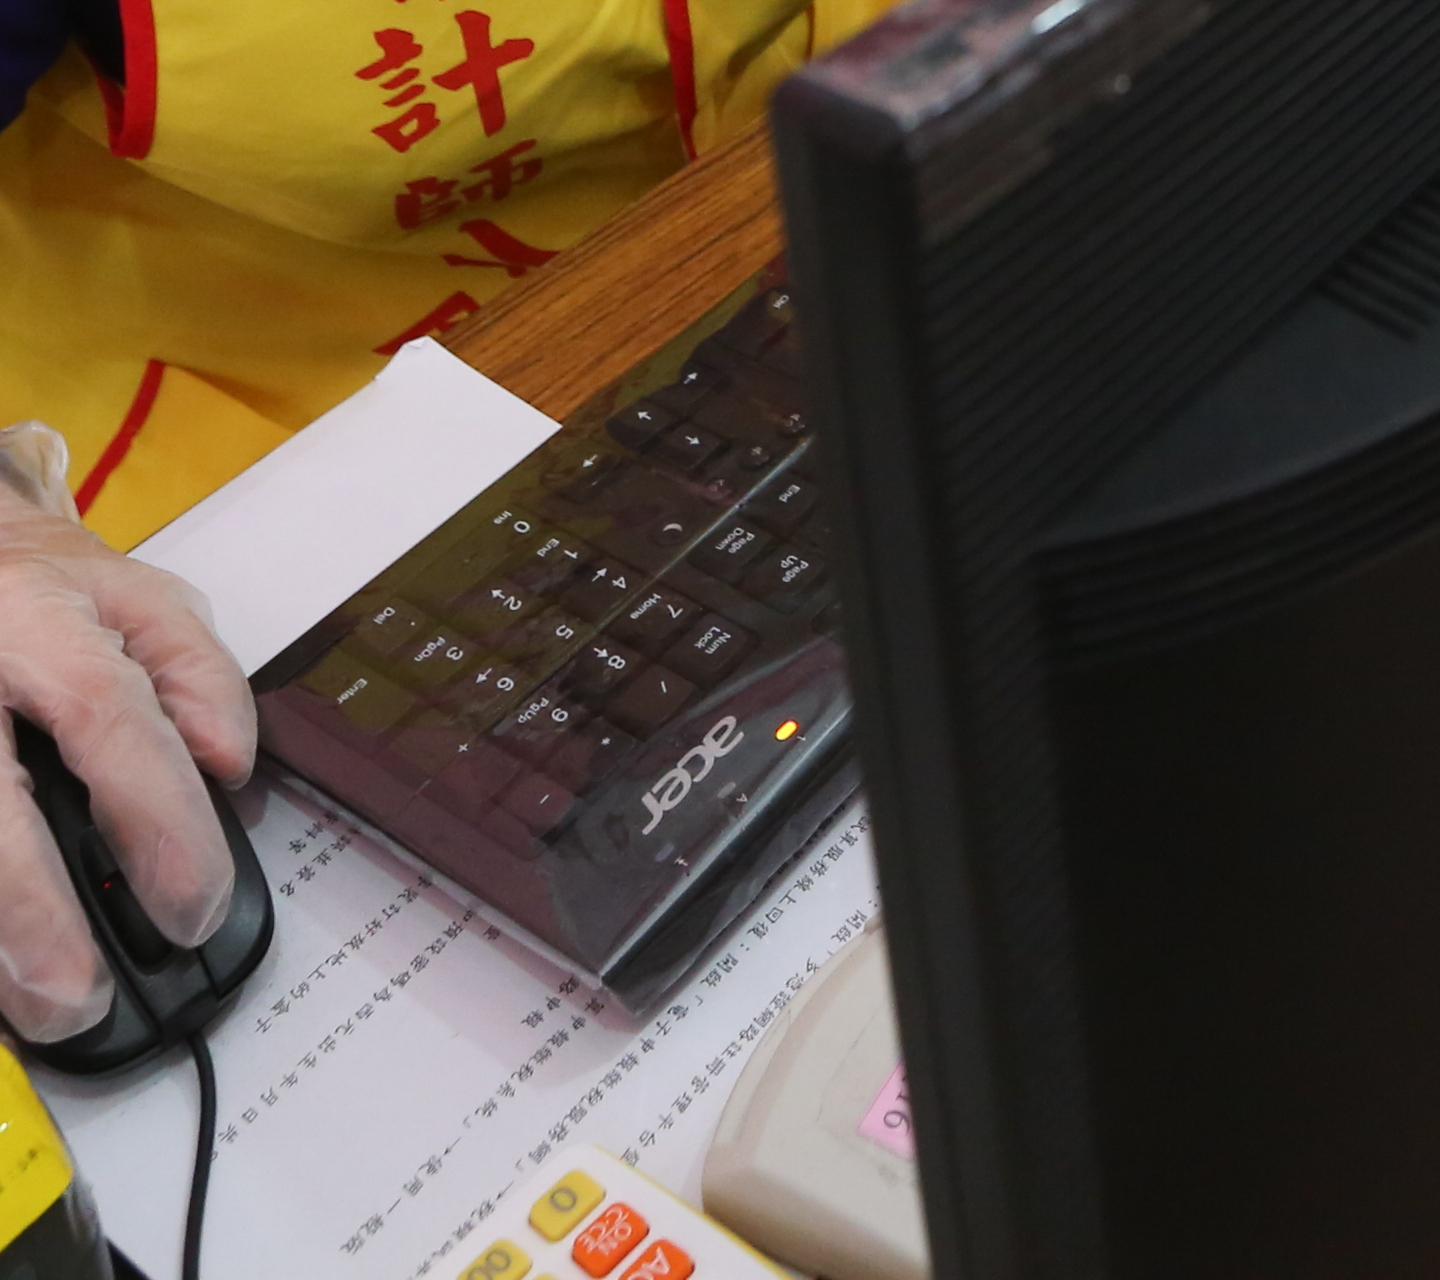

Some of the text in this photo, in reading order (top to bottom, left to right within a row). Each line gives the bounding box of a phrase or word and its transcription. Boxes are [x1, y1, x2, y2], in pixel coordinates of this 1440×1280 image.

[779, 484, 801, 503] End
[494, 510, 512, 524] Ins
[513, 520, 530, 533] 0
[537, 538, 559, 557] End
[715, 527, 744, 550] Down
[728, 532, 755, 554] Page
[564, 549, 578, 559] 1
[781, 555, 798, 568] Up
[782, 560, 809, 583] Page
[612, 576, 627, 589] 4
[503, 595, 522, 611] 2
[630, 593, 662, 620] Home
[667, 604, 683, 618] 7
[373, 606, 395, 625] Del
[555, 624, 574, 639] 5
[694, 626, 721, 649] Lock
[414, 636, 446, 662] PgDn
[705, 632, 731, 654] Num
[446, 646, 463, 661] 3
[608, 655, 626, 669] 8
[336, 677, 368, 705] Enter
[496, 677, 514, 691] 6
[518, 697, 550, 723] PgUp
[551, 708, 568, 722] 9
[641, 715, 745, 836] acer
[277, 823, 360, 901] 誤並簽名
[549, 1187, 577, 1212] 0
